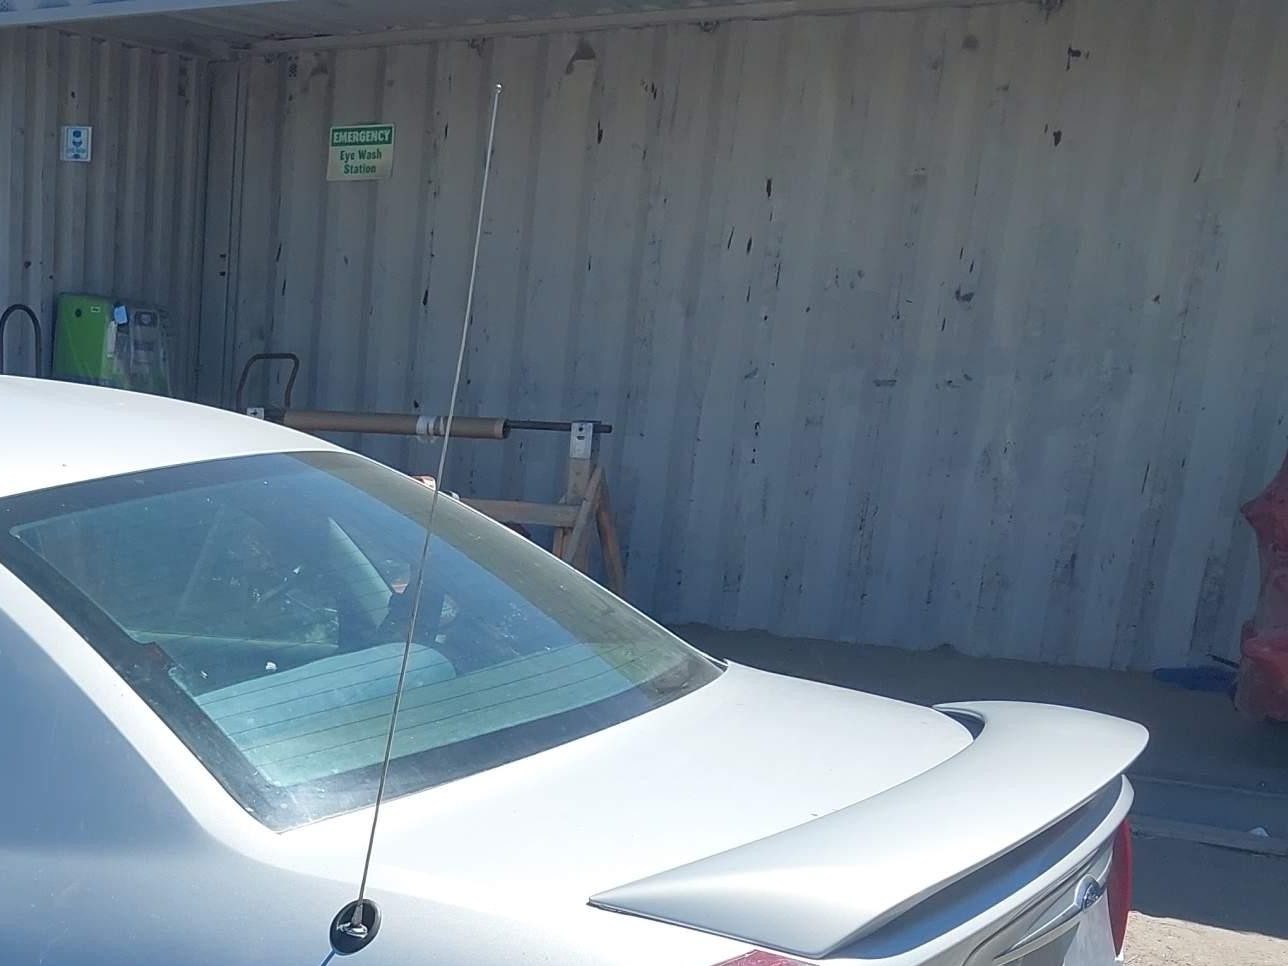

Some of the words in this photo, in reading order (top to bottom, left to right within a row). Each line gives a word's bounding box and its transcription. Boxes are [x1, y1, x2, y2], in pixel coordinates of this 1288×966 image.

[333, 129, 390, 144] EMERGENCY
[340, 150, 355, 163] Eye
[358, 148, 382, 160] Wash
[343, 163, 376, 174] Station
